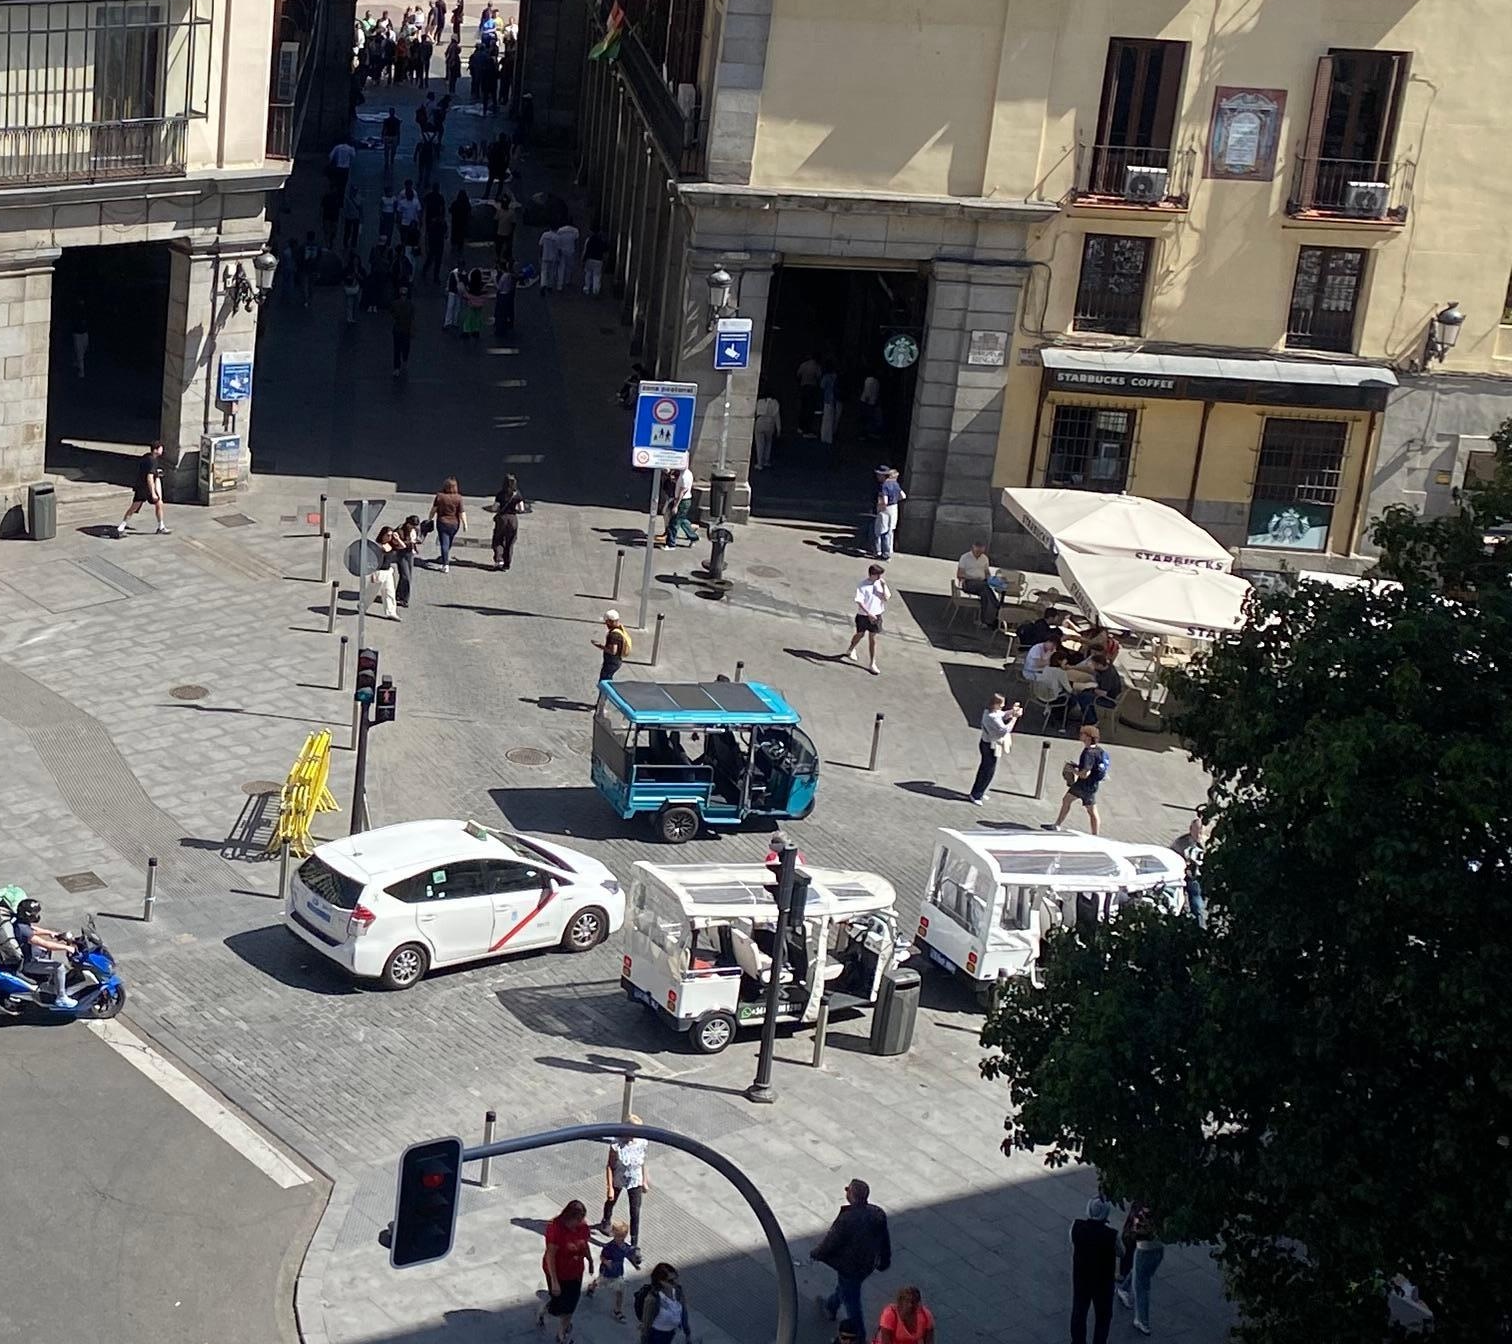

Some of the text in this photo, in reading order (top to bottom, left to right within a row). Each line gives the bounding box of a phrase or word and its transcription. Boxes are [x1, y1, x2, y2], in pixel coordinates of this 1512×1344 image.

[1057, 372, 1175, 389] STARBUCKS COFFEE
[1135, 551, 1224, 571] STARBUCKS
